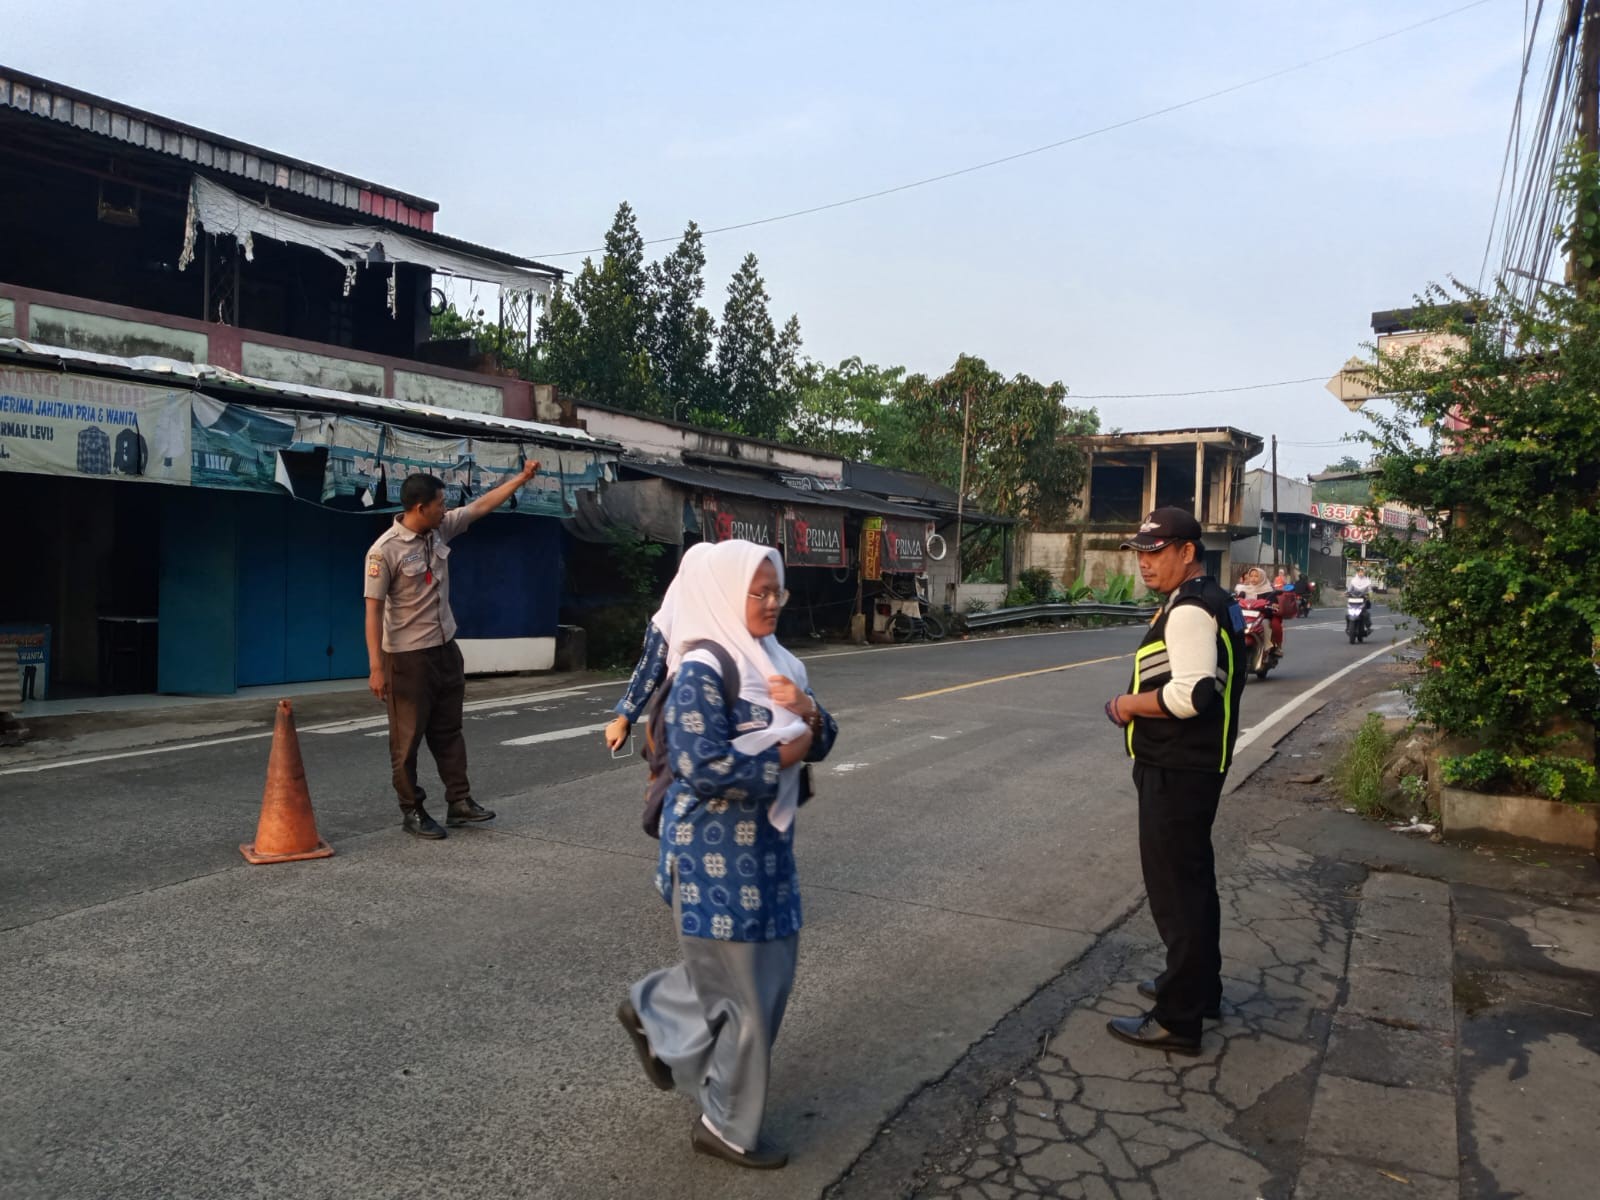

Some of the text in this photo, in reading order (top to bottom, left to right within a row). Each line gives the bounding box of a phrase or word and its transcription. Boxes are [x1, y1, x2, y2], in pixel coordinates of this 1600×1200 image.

[36, 401, 73, 419] JAHITAN
[76, 404, 96, 422] PRIA
[98, 408, 104, 423] &
[106, 409, 137, 426] WANITA
[730, 520, 770, 545] PRIMA
[805, 528, 840, 549] PRIMA
[895, 538, 923, 556] PRIMA
